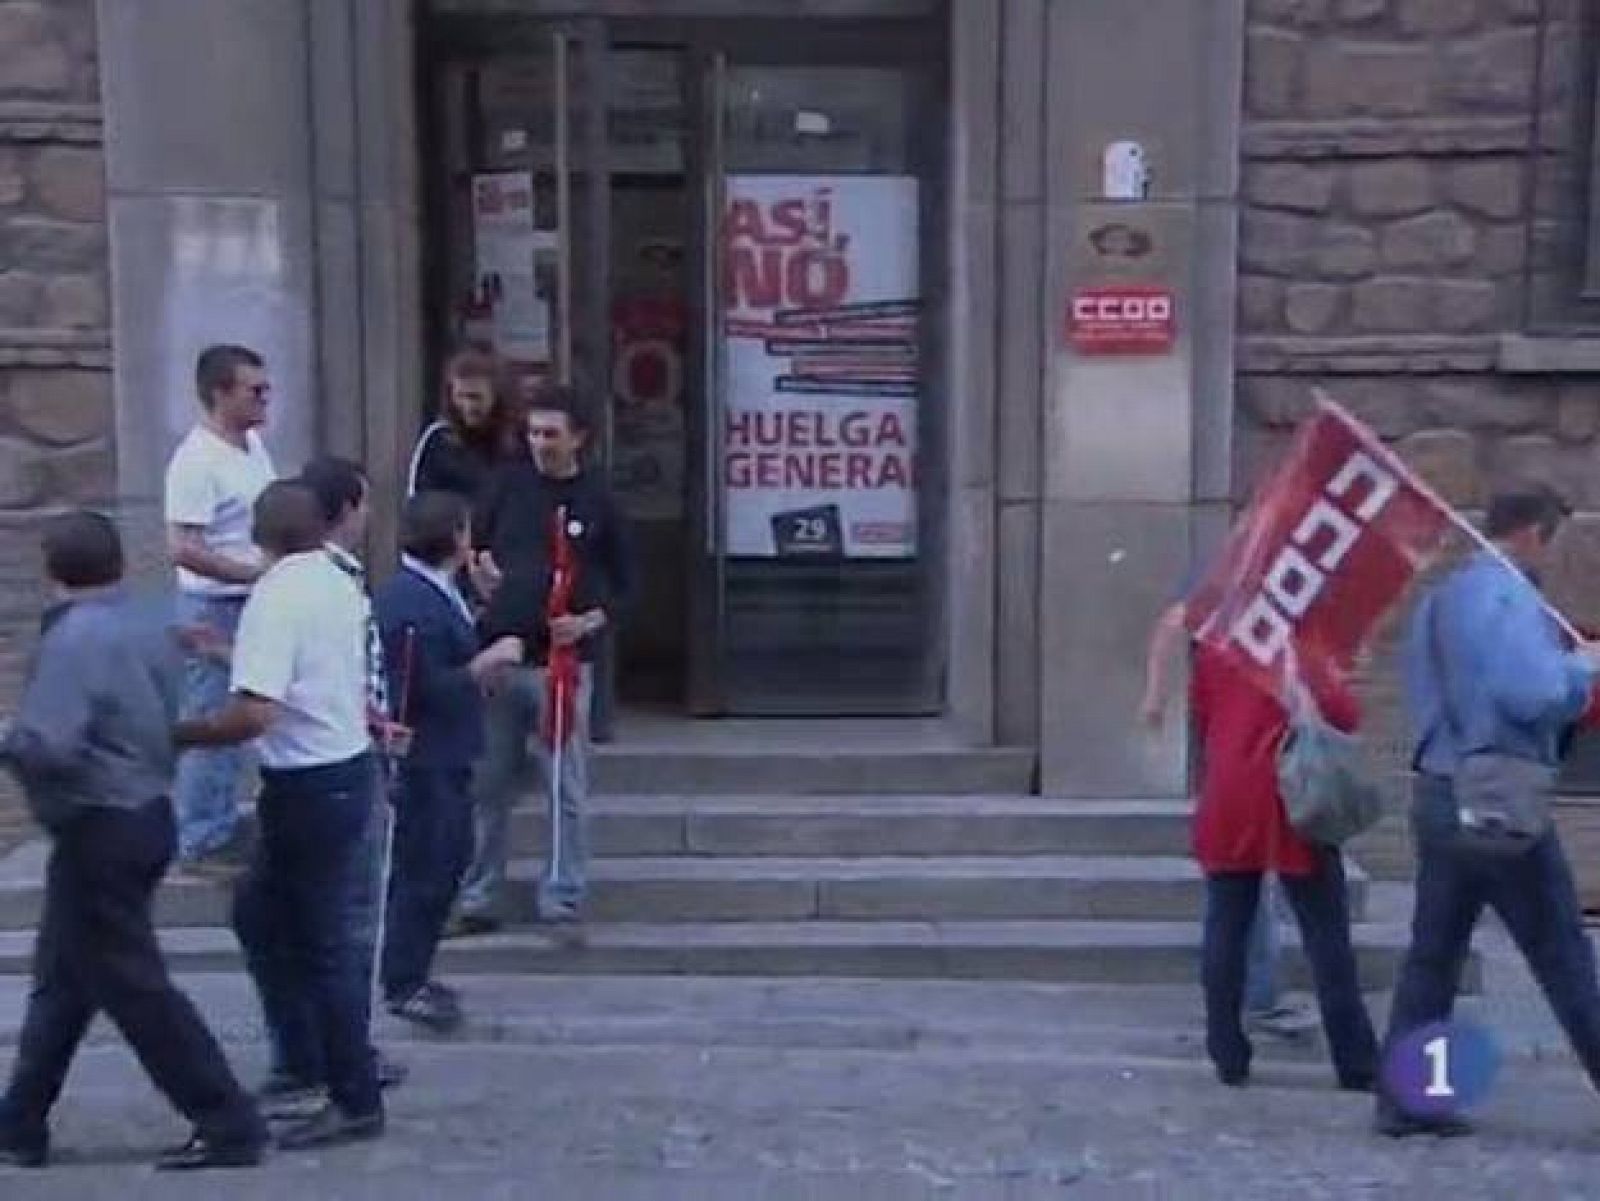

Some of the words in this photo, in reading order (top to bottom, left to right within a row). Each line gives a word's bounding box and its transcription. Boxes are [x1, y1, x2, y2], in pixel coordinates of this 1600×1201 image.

[725, 248, 848, 309] NO
[1074, 296, 1171, 321] CCOO
[726, 411, 905, 446] HUELGA
[794, 518, 826, 541] 29
[1229, 450, 1398, 665] CCOO
